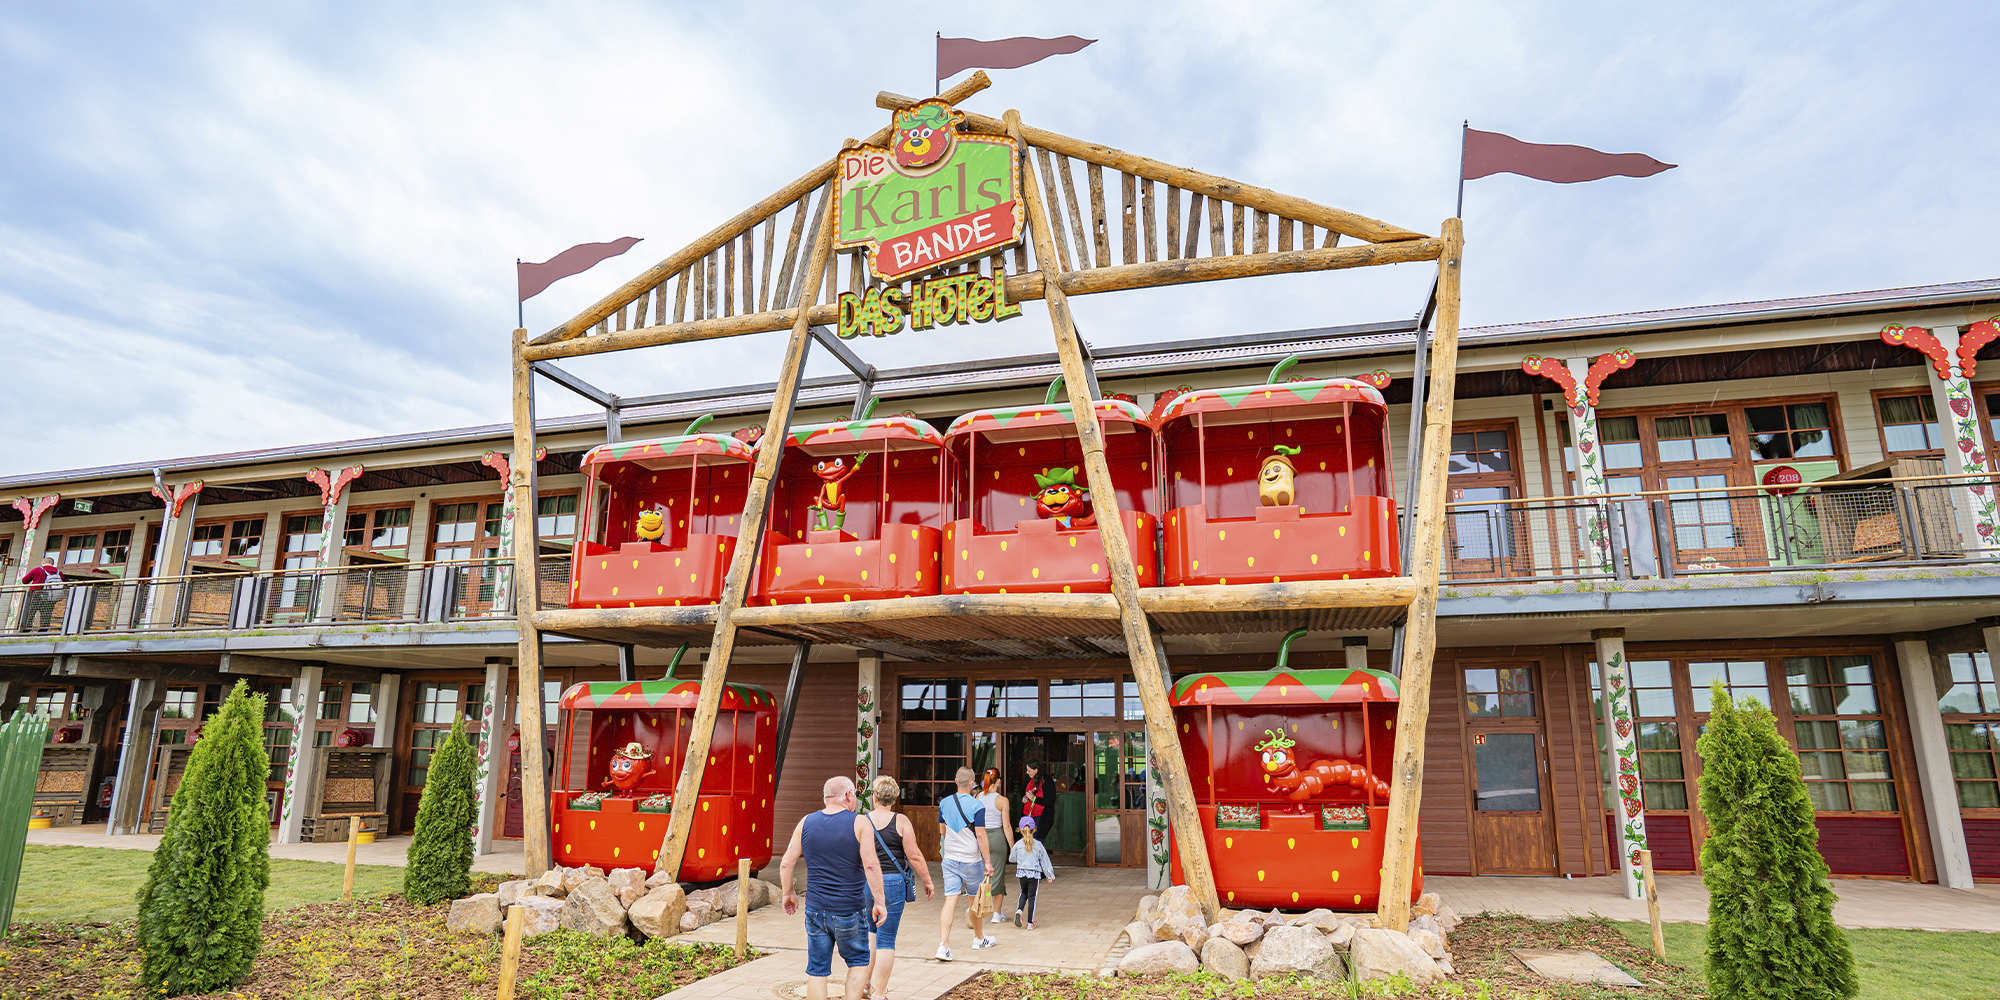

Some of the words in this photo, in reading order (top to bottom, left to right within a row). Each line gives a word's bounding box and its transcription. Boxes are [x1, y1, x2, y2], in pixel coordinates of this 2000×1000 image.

[846, 154, 885, 181] Die
[849, 162, 1002, 232] Karls
[892, 213, 996, 268] BANDE
[837, 285, 905, 339] DAS
[1779, 474, 1799, 482] 208
